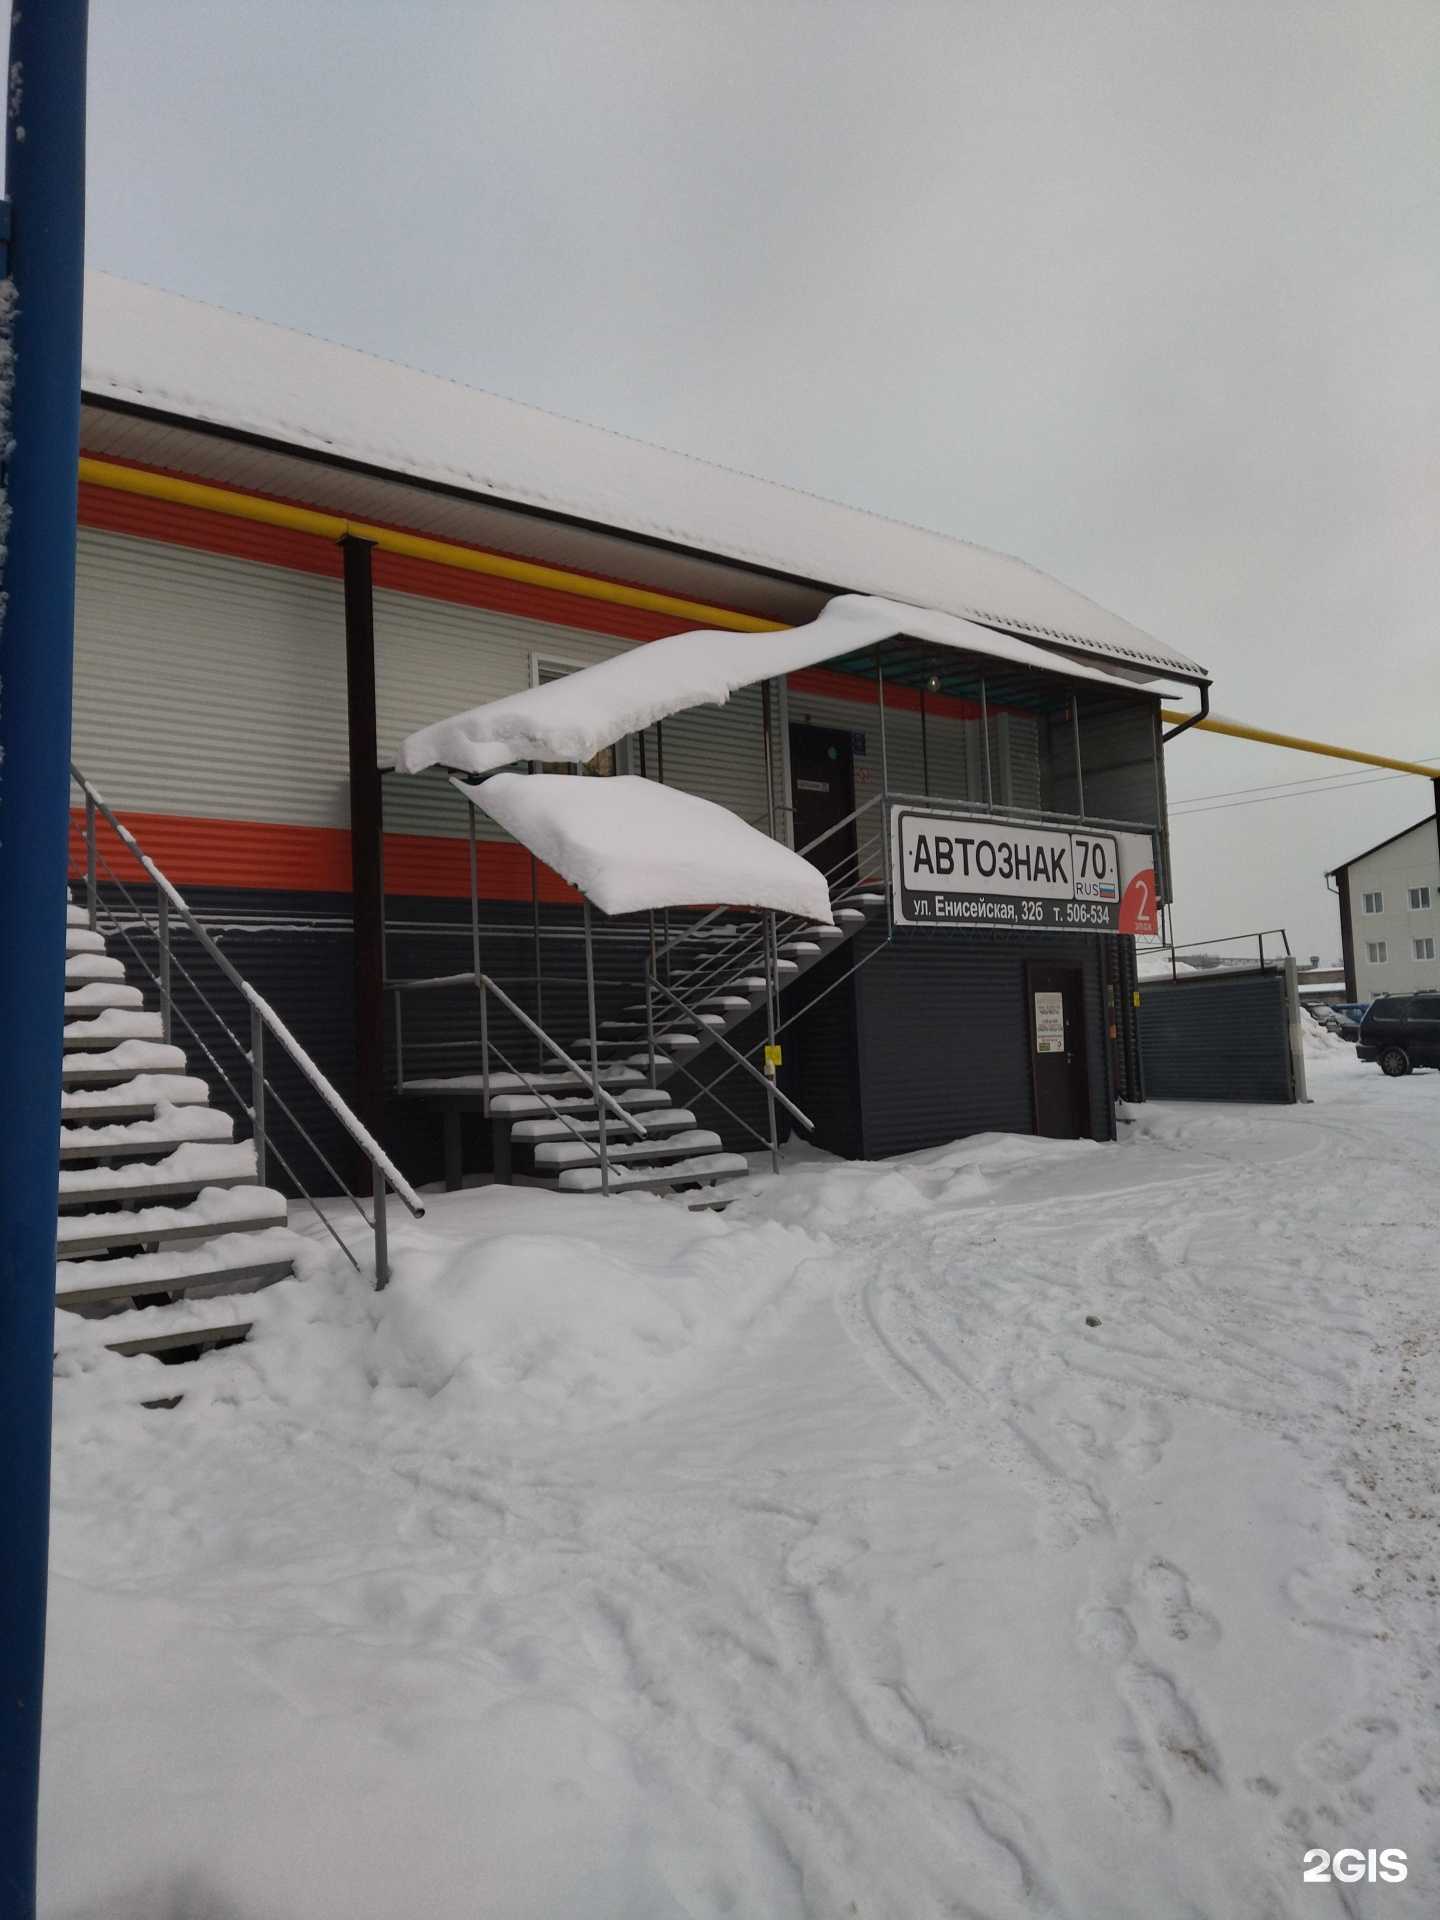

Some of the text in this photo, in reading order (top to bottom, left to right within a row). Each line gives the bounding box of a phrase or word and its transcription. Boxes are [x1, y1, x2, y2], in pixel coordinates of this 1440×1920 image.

[913, 834, 1106, 884] АВТОЗНАК 70
[1076, 882, 1099, 896] RUS
[1135, 880, 1150, 921] 2
[913, 899, 932, 916] ул.
[935, 895, 1018, 922] Енисейская,
[1053, 907, 1063, 921] т.
[1066, 903, 1110, 924] 506-534
